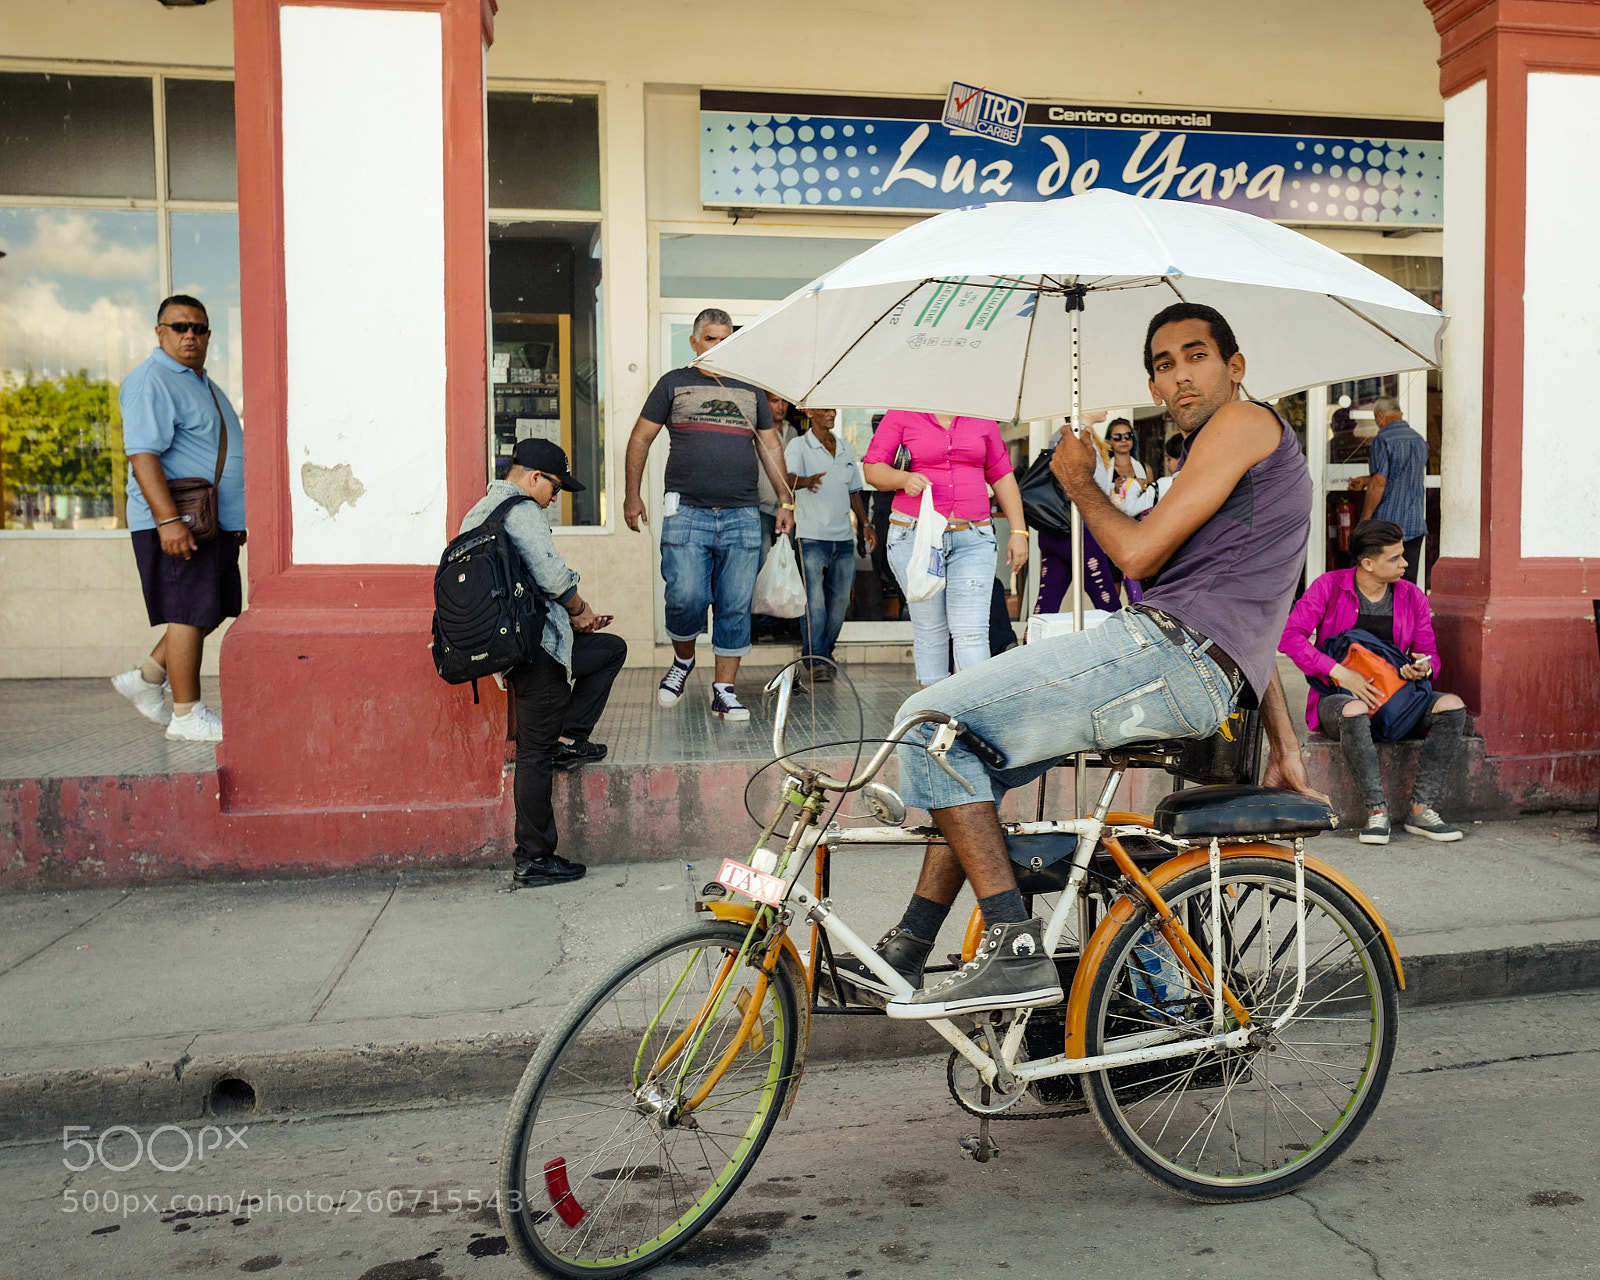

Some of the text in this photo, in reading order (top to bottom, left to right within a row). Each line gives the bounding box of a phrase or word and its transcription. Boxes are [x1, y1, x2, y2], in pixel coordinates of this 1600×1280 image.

[983, 93, 1023, 127] TRD
[1048, 106, 1212, 127] Centro comercial
[977, 122, 1018, 142] CARIBE
[881, 122, 1286, 201] Luz de Yara
[725, 864, 781, 902] TAXI
